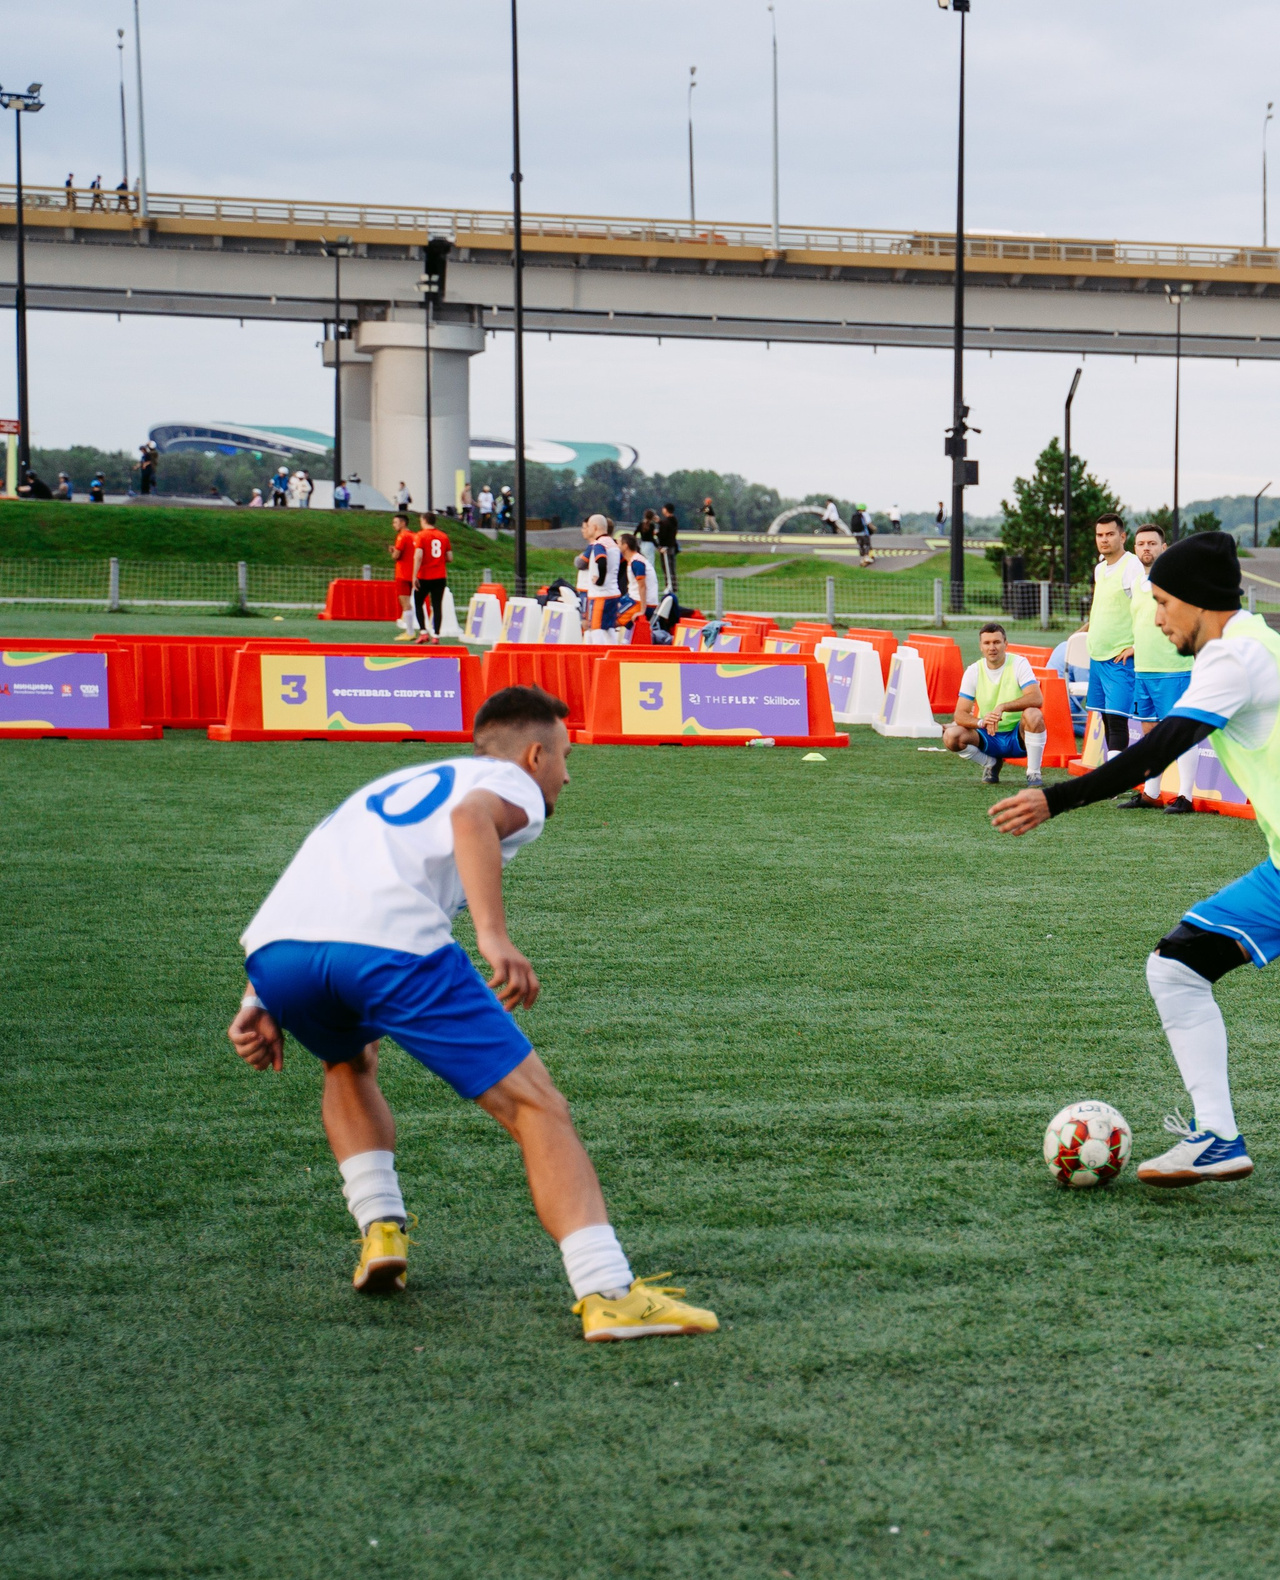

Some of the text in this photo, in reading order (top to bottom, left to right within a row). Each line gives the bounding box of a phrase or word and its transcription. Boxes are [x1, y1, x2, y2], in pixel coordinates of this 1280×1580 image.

[431, 539, 442, 558] 8
[281, 675, 307, 705] 3
[639, 682, 664, 711] 3
[763, 696, 800, 706] Skillbox
